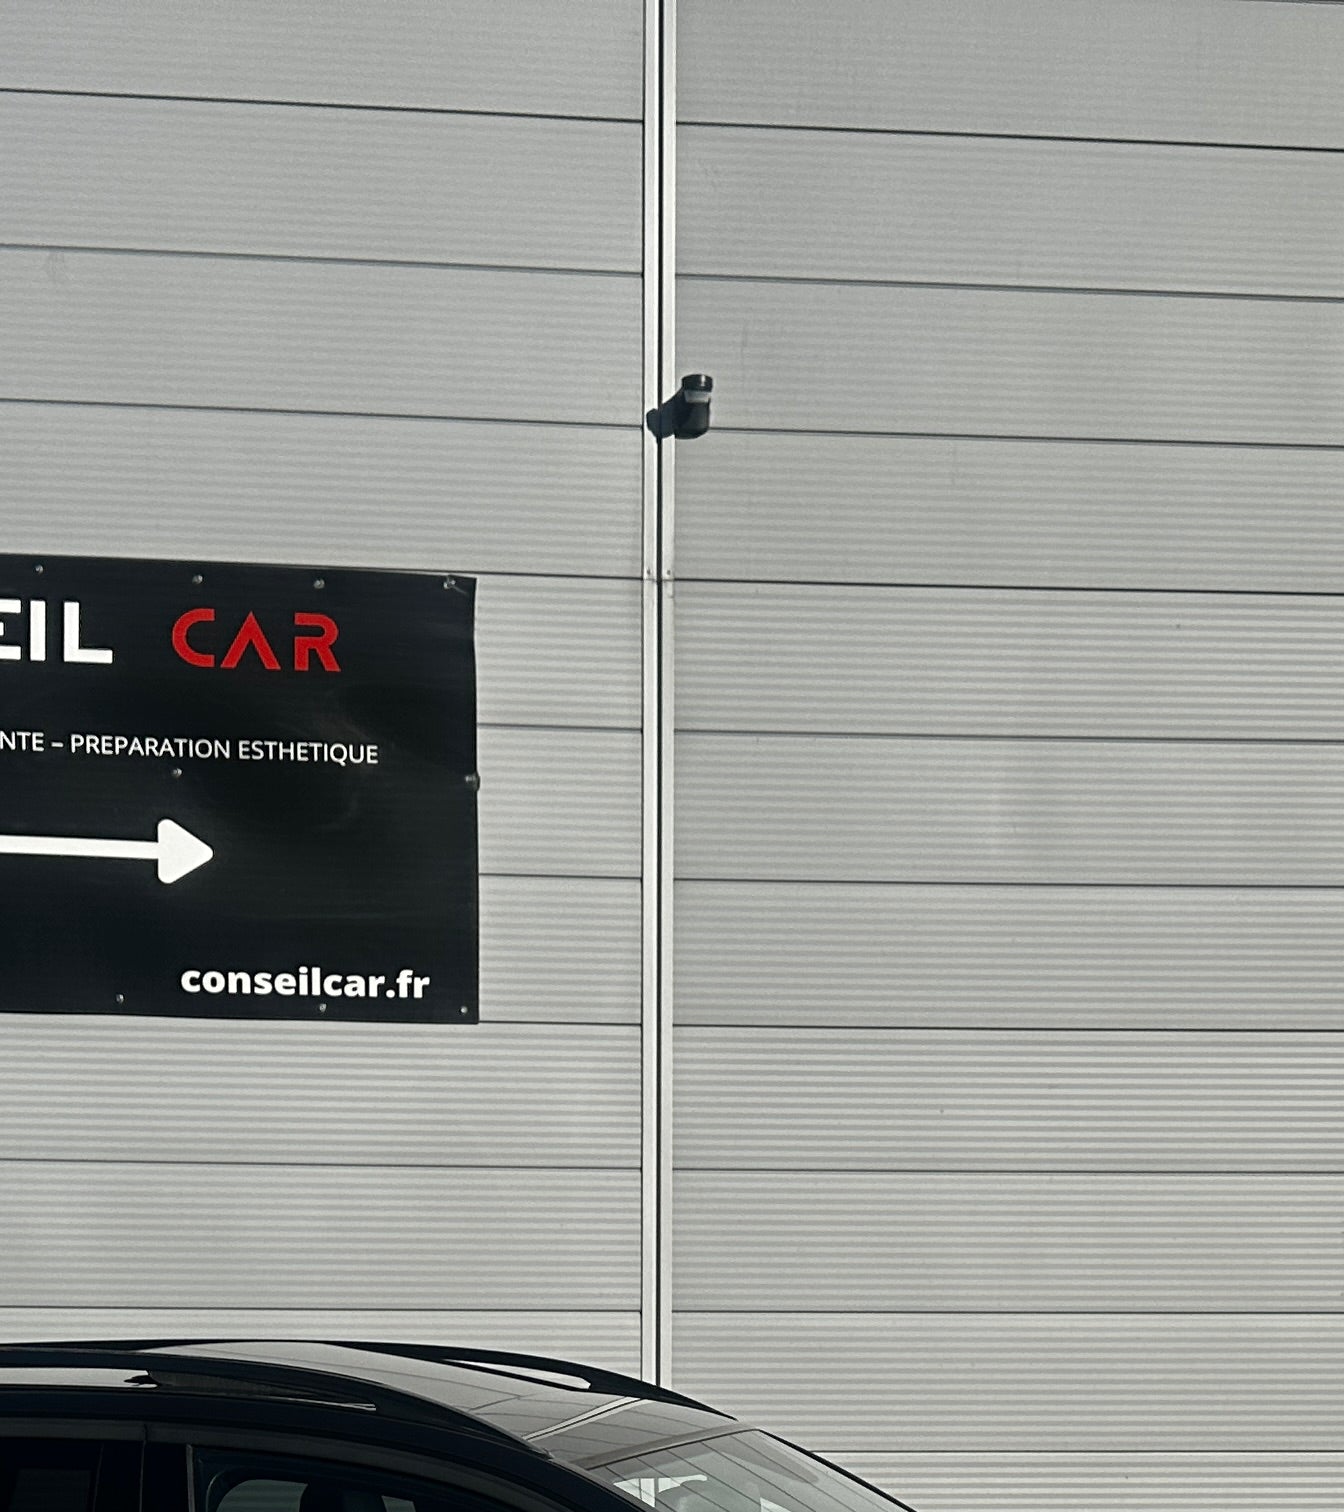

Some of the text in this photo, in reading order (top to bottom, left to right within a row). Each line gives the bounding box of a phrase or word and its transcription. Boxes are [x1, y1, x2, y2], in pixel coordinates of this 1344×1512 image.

[172, 608, 341, 672] CAR
[70, 733, 231, 759] PREPARATION
[238, 740, 379, 767] ESTHETIQUE
[180, 966, 431, 999] conseilcar.fr
